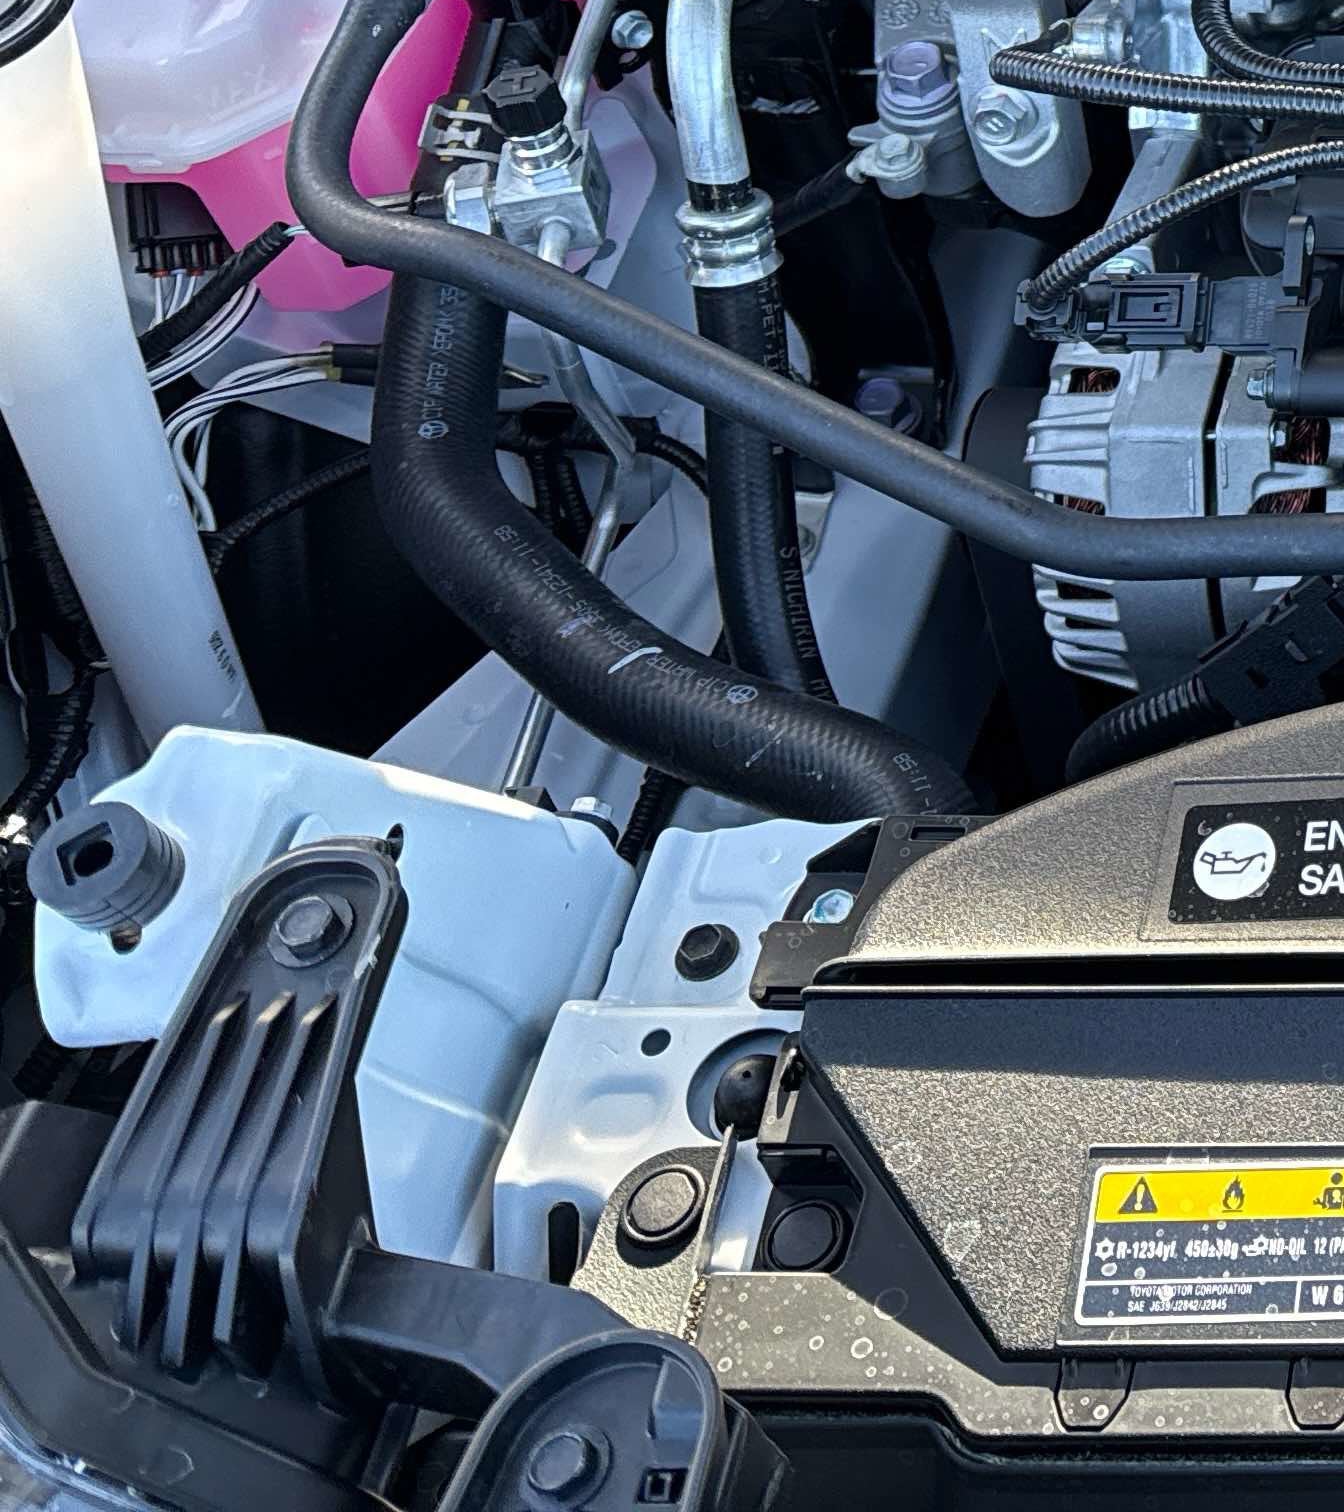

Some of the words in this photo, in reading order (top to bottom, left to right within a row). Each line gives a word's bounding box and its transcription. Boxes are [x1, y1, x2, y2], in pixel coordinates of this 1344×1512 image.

[1314, 1237, 1326, 1254] 12
[1130, 1285, 1161, 1297] TOYOTA
[1195, 1283, 1252, 1296] CORPORATION
[1312, 1286, 1329, 1305] W
[1333, 1284, 1344, 1305] 6
[1127, 1301, 1145, 1313] SAE
